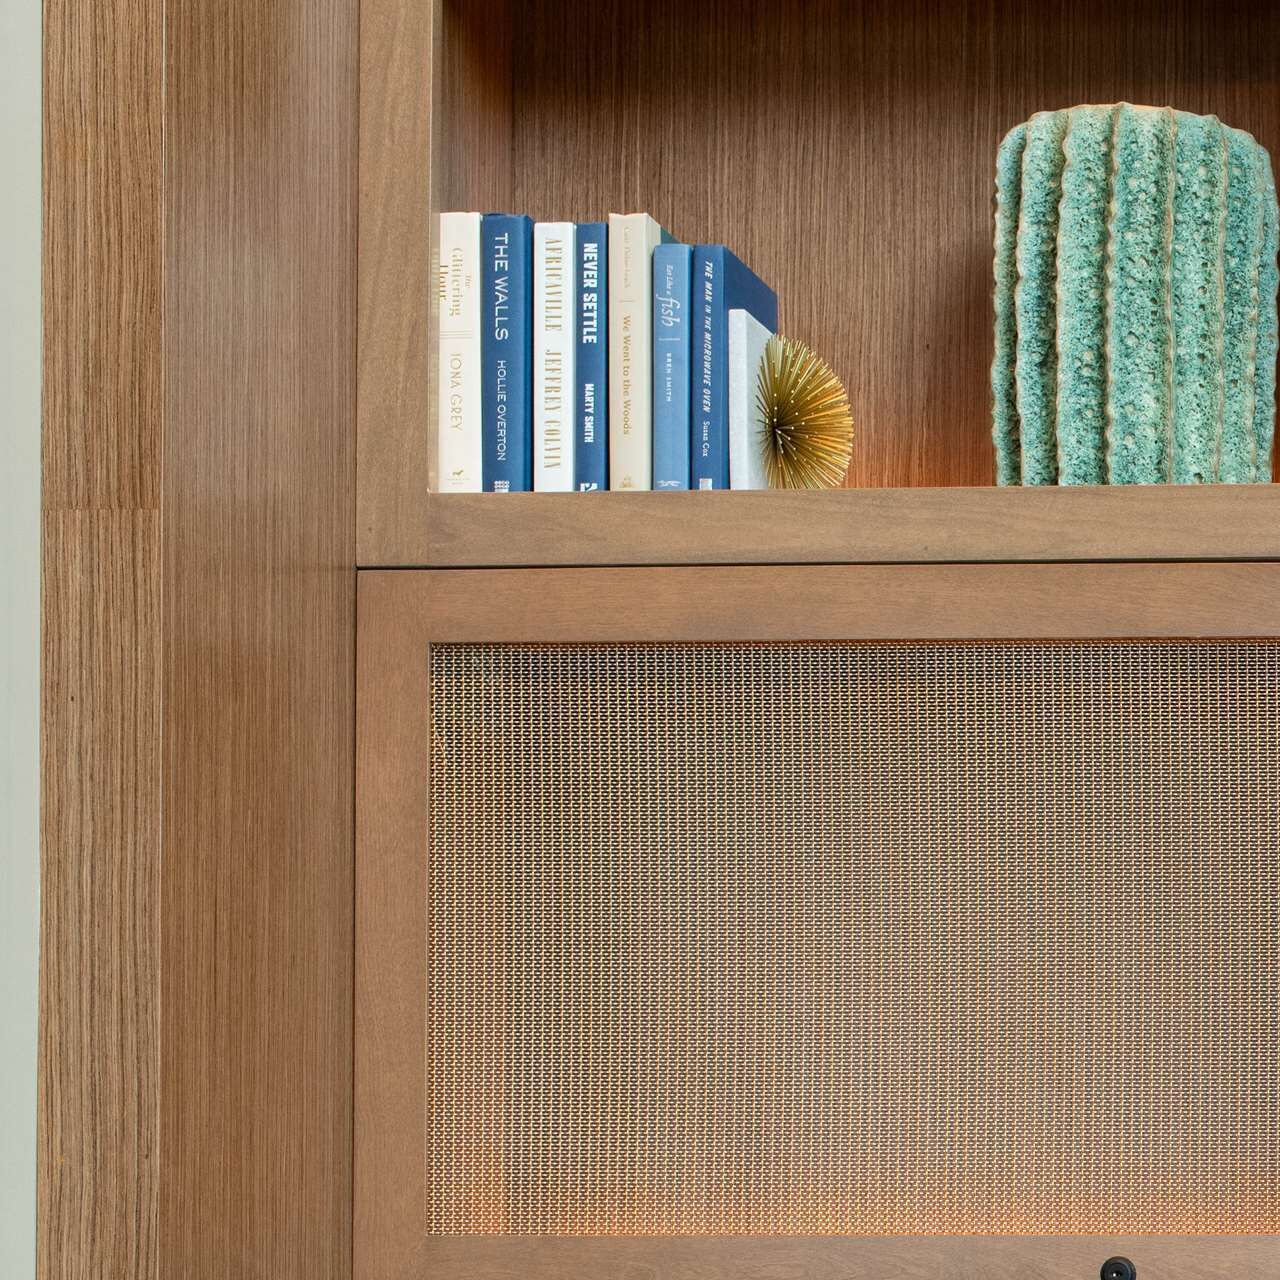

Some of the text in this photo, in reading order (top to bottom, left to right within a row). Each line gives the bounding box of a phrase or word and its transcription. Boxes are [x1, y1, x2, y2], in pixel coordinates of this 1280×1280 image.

[449, 247, 464, 317] Glittering
[494, 232, 509, 341] THE WALLS
[544, 237, 563, 331] AFRICAVILLE
[583, 243, 598, 344] NEVER SETTLE
[656, 293, 681, 327] fish
[622, 315, 632, 435] We Went to the Woods
[702, 260, 714, 413] THE MAN IN THE MICROWAVE OVEN
[450, 353, 463, 431] IONA GREY
[497, 359, 507, 461] HOLLIE OVERTON
[543, 349, 562, 469] JEFFREY COLVIN
[584, 383, 595, 443] MARTY SMITH
[702, 421, 711, 457] Susan Cox
